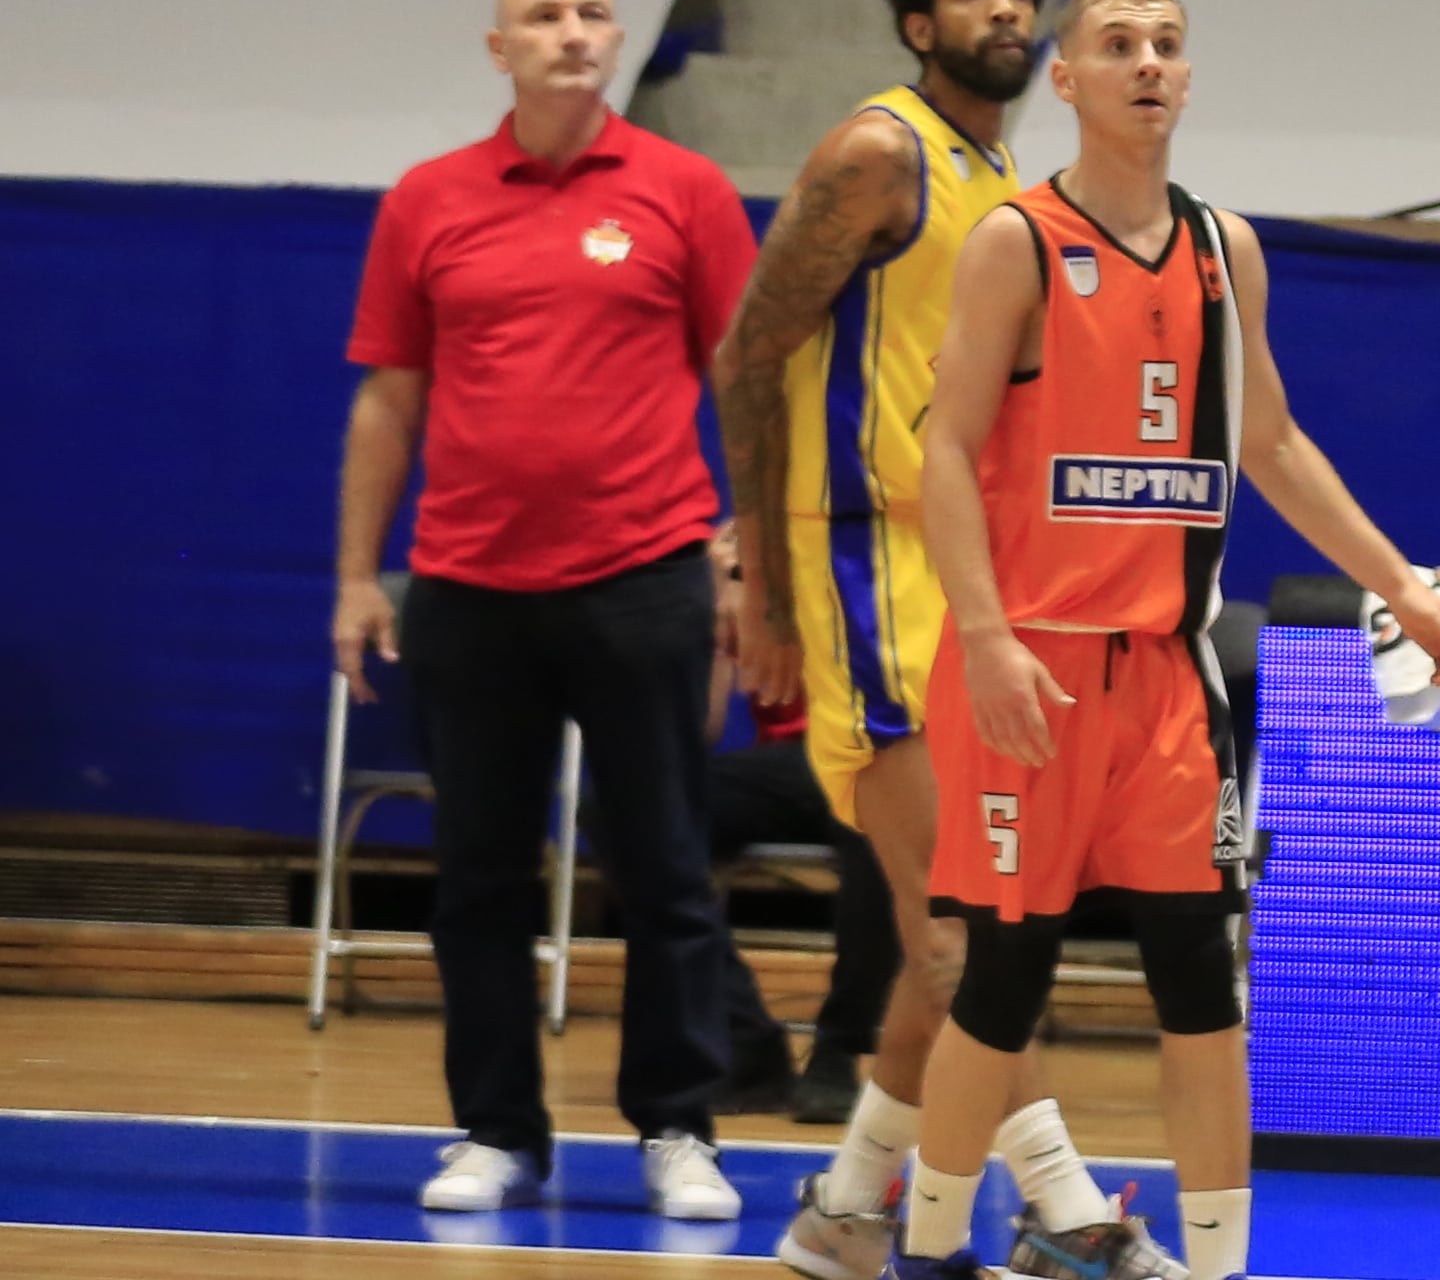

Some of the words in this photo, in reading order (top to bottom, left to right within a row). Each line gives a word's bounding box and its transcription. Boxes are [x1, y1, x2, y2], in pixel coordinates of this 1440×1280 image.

[1138, 360, 1179, 443] 5
[1065, 465, 1211, 504] NEPTN
[980, 791, 1020, 876] 5
